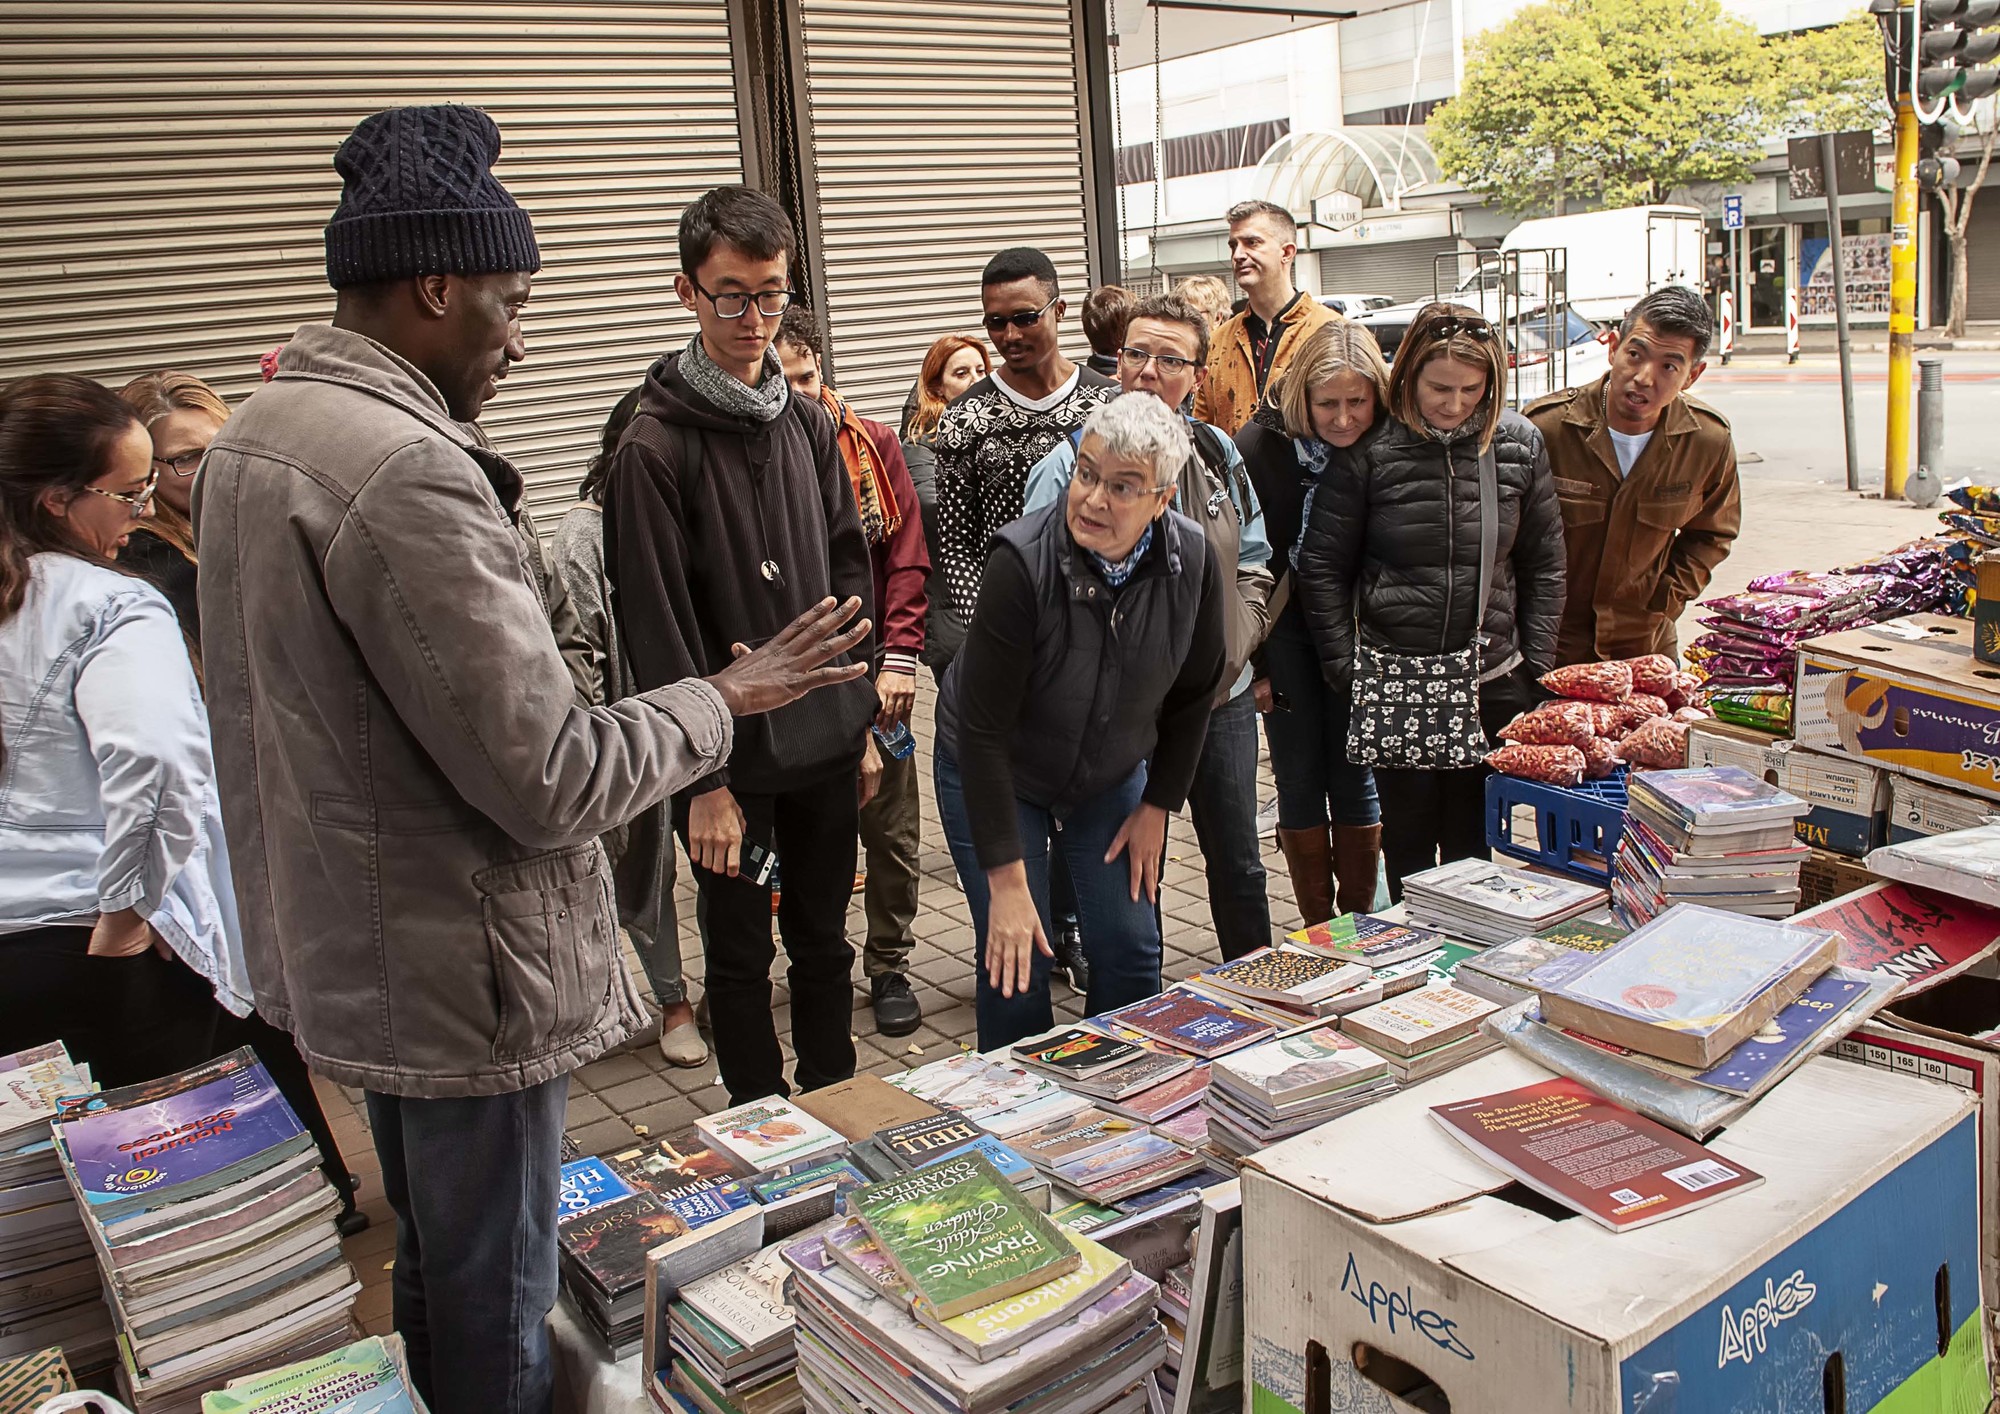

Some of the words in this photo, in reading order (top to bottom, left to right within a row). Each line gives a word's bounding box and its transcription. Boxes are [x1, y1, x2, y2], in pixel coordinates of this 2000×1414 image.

[1323, 211, 1358, 222] ARCADE
[1728, 210, 1739, 225] R
[1912, 706, 2000, 745] Bananas
[1764, 752, 1786, 767] 18kg
[1825, 773, 1856, 785] MEDIUM
[1833, 785, 1856, 794] LARGE
[1808, 789, 1831, 799] LARGE
[1831, 793, 1855, 804] EXTRA
[1363, 932, 1420, 954] OXFORD
[1416, 990, 1447, 1007] FROM
[1445, 1001, 1478, 1016] MARS
[1440, 988, 1460, 1001] MEN
[1459, 993, 1482, 1007] ARE
[1191, 1020, 1235, 1040] AFRICAN
[1195, 1021, 1220, 1035] WAY
[1209, 1027, 1235, 1039] THE
[1842, 1042, 1859, 1055] 135
[1869, 1049, 1887, 1061] 150
[1896, 1056, 1914, 1068] 165
[1924, 1062, 1942, 1075] 180
[1473, 1110, 1495, 1120] The
[1495, 1102, 1536, 1117] Practice
[1538, 1096, 1550, 1108] of
[1549, 1094, 1565, 1104] the
[1480, 1110, 1528, 1127] Presence
[1528, 1105, 1539, 1117] of
[1539, 1102, 1561, 1115] God
[1561, 1096, 1580, 1107] and
[1484, 1123, 1508, 1134] The
[1507, 1112, 1551, 1130] Spiritual
[1551, 1101, 1592, 1117] Maxims
[116, 1108, 238, 1152] Sciences
[1518, 1121, 1549, 1134] BROTHER
[1549, 1112, 1582, 1127] LAWRENCE
[132, 1121, 234, 1163] Natural
[892, 1122, 979, 1156] HELL
[972, 1140, 988, 1151] OF
[560, 1168, 605, 1192] HA
[586, 1185, 605, 1195] The
[712, 1174, 733, 1185] THE
[864, 1161, 971, 1203] OMARTIAN
[893, 1165, 980, 1206] STORMIE
[558, 1189, 591, 1211] 8
[680, 1201, 698, 1219] Mini
[687, 1195, 712, 1218] School
[921, 1200, 1009, 1238] Children
[1001, 1220, 1025, 1239] for
[929, 1221, 997, 1258] Adult
[980, 1229, 1006, 1246] Your
[926, 1229, 1038, 1279] PRAYING
[981, 1252, 1019, 1272] Power
[1018, 1244, 1046, 1262] The
[1143, 1248, 1168, 1264] YOUR
[966, 1265, 981, 1280] of
[718, 1267, 748, 1292] SON
[744, 1286, 763, 1302] OF
[760, 1300, 795, 1322] GOD
[976, 1256, 1095, 1331] Afrikaans
[693, 1285, 717, 1306] RICK
[717, 1300, 760, 1333] WARREN
[1340, 1251, 1476, 1361] Apples
[1718, 1269, 1817, 1370] Apples
[305, 1356, 346, 1375] CHRISTIAAN
[307, 1371, 359, 1395] South
[333, 1380, 380, 1405] Child
[248, 1391, 303, 1414] Africa
